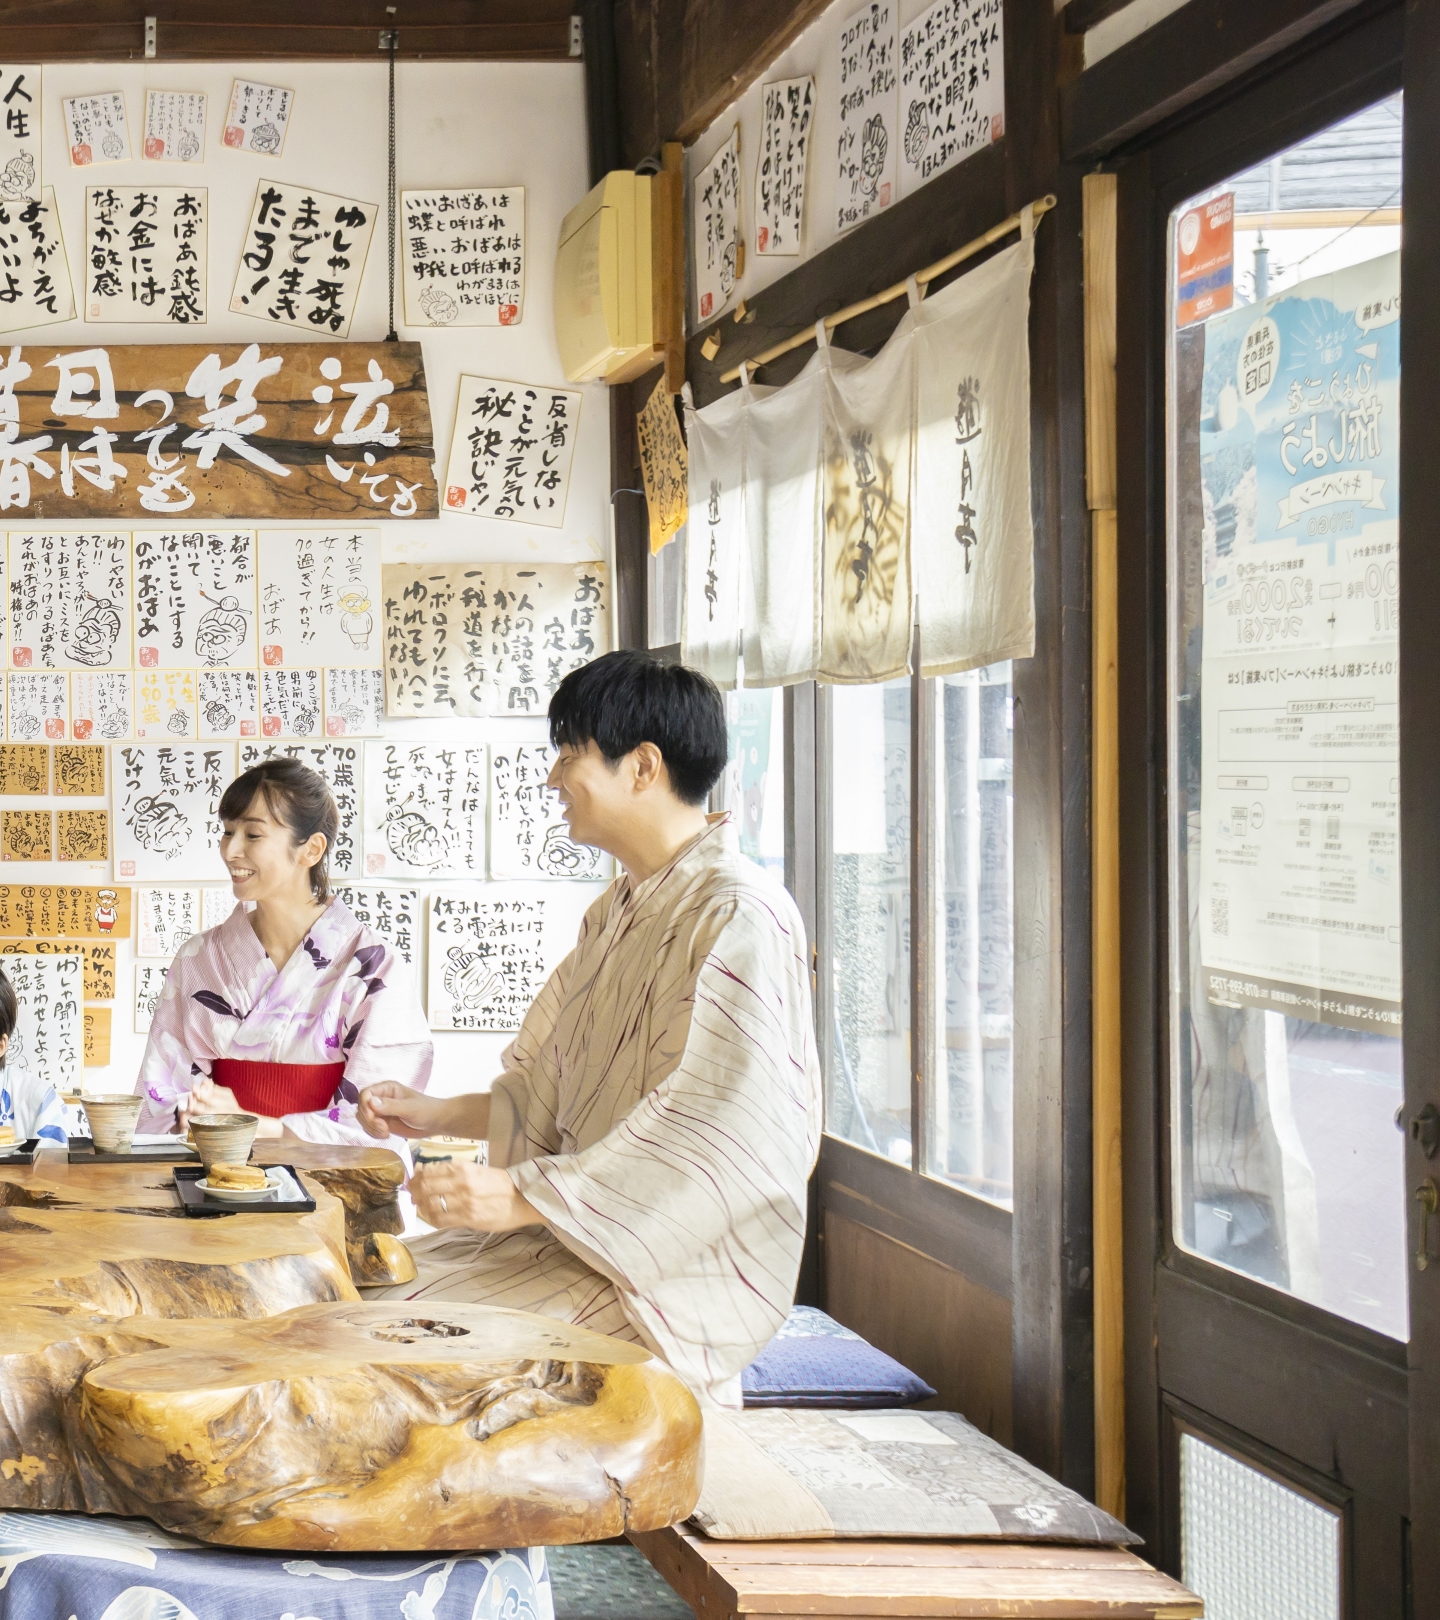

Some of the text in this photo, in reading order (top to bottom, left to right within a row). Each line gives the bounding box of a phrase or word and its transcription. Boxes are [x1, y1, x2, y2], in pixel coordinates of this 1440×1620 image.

[841, 4, 889, 52] コロナに負け
[3, 74, 33, 139] 人生
[921, 116, 990, 179] ほんまかいな!?
[406, 193, 510, 212] いいおばあは
[408, 213, 505, 232] 蝶と呼ばれ
[91, 189, 124, 297] なぜか敏感
[127, 192, 166, 307] お金には
[167, 193, 204, 323] おばあ鈍感
[242, 187, 287, 305] たる!
[268, 196, 331, 320] まで生き
[410, 233, 522, 258] 悪いおばあは
[413, 256, 521, 280] 蛾と呼ばれる
[457, 279, 521, 291] わがままは
[459, 292, 520, 306] ほどほどに
[43, 347, 127, 496] 日は
[133, 343, 292, 513] 笑っても
[312, 357, 422, 517] 泣いても
[467, 387, 517, 512] 秘訣じゃ!
[534, 396, 569, 510] 反省しない
[495, 390, 538, 517] ことが元気の
[92, 535, 105, 565] で!!
[182, 532, 203, 577] 聞いて
[207, 534, 227, 591] 悪いこと
[230, 535, 253, 584] 都合が
[318, 536, 339, 615] 女の人生は
[346, 535, 364, 583] 本当の
[57, 537, 70, 642] とお互いにミスを
[135, 541, 163, 638] のがおばあ
[160, 535, 186, 648] ないことにする
[263, 583, 285, 636] おばあ
[295, 538, 315, 645] 70過ぎてから!!
[141, 673, 161, 724] は90歳
[165, 672, 182, 710] ピーク
[181, 673, 195, 703] 人生
[290, 670, 302, 707] 男前に
[121, 747, 145, 812] ひけつ!
[184, 751, 202, 793] ことが
[383, 746, 405, 805] 乙女じゃ
[408, 746, 435, 812] 死ぬまで
[494, 756, 510, 820] のじゃ!!
[332, 747, 358, 872] 70歳、おばあ界
[463, 748, 482, 870] だんなはすてても
[514, 747, 534, 866] 人生何とかなる
[168, 892, 176, 925] ヒソヒソ
[182, 891, 194, 924] おばあの
[433, 896, 546, 916] 休みにかかって
[501, 958, 546, 975] 出たら
[34, 959, 49, 1080] と言わせんように
